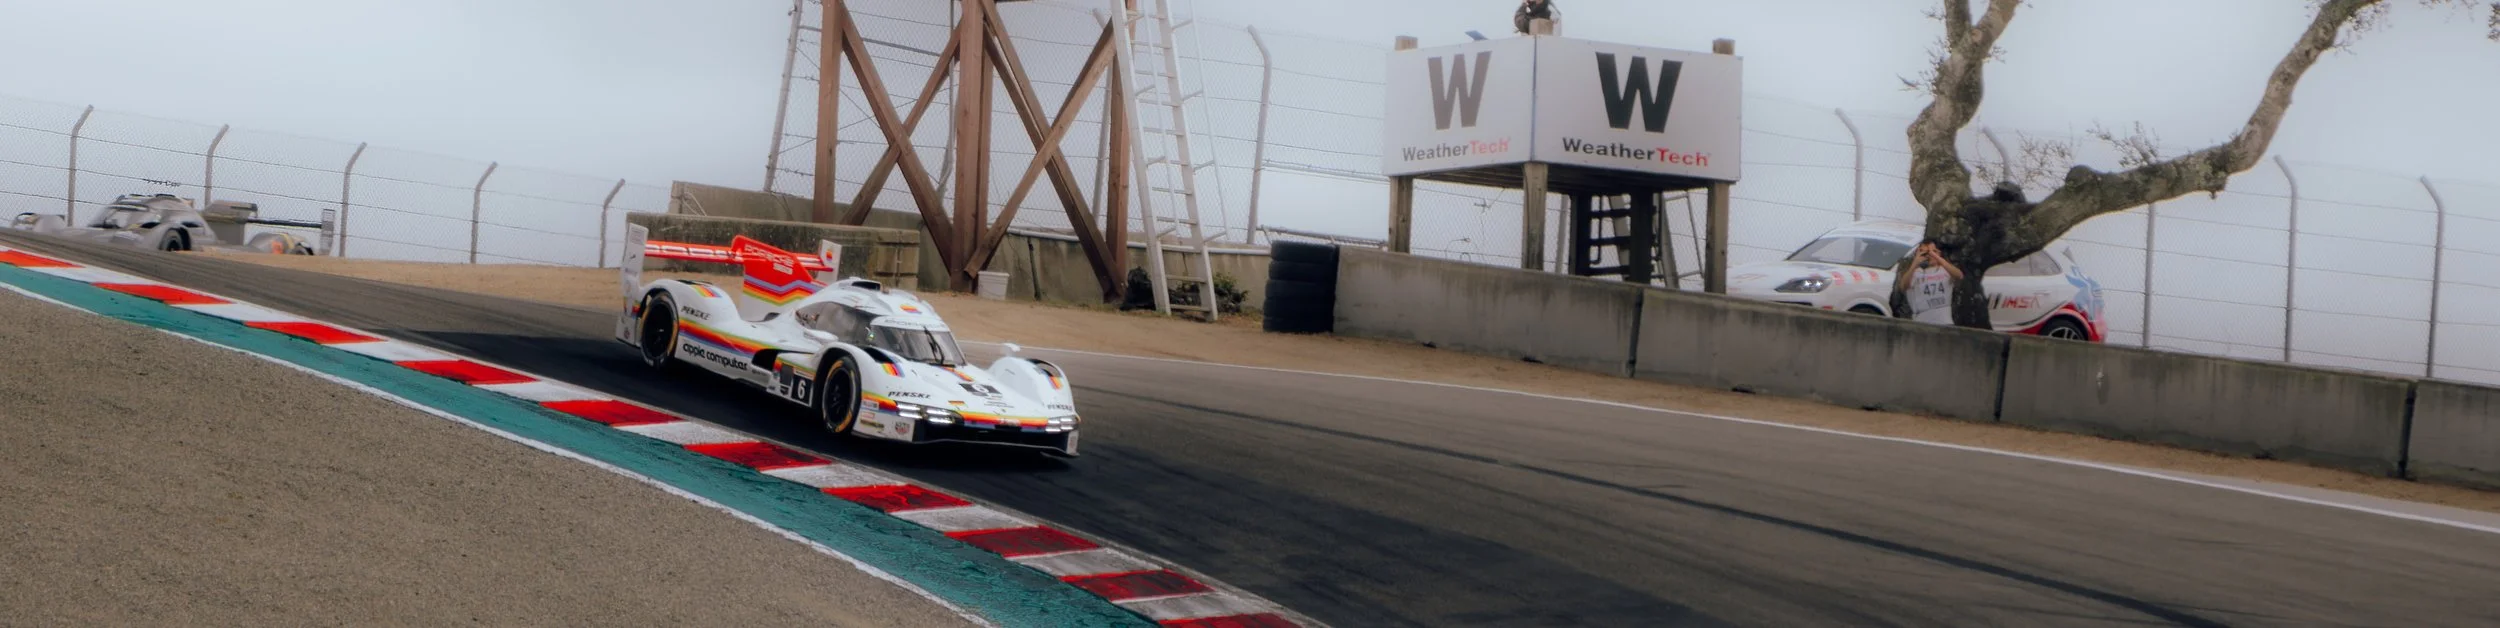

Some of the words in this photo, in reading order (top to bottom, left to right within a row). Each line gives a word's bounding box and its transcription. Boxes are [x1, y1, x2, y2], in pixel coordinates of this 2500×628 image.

[1428, 50, 1492, 131] W
[1595, 51, 1683, 133] W
[1402, 138, 1509, 162] WeatherTech
[1562, 137, 1709, 167] WeatherTech
[1923, 282, 1945, 296] 474
[681, 306, 711, 320] PENSKE
[682, 342, 705, 359] apple
[706, 351, 748, 371] computer
[797, 379, 806, 399] 6
[888, 391, 931, 399] PENSKE
